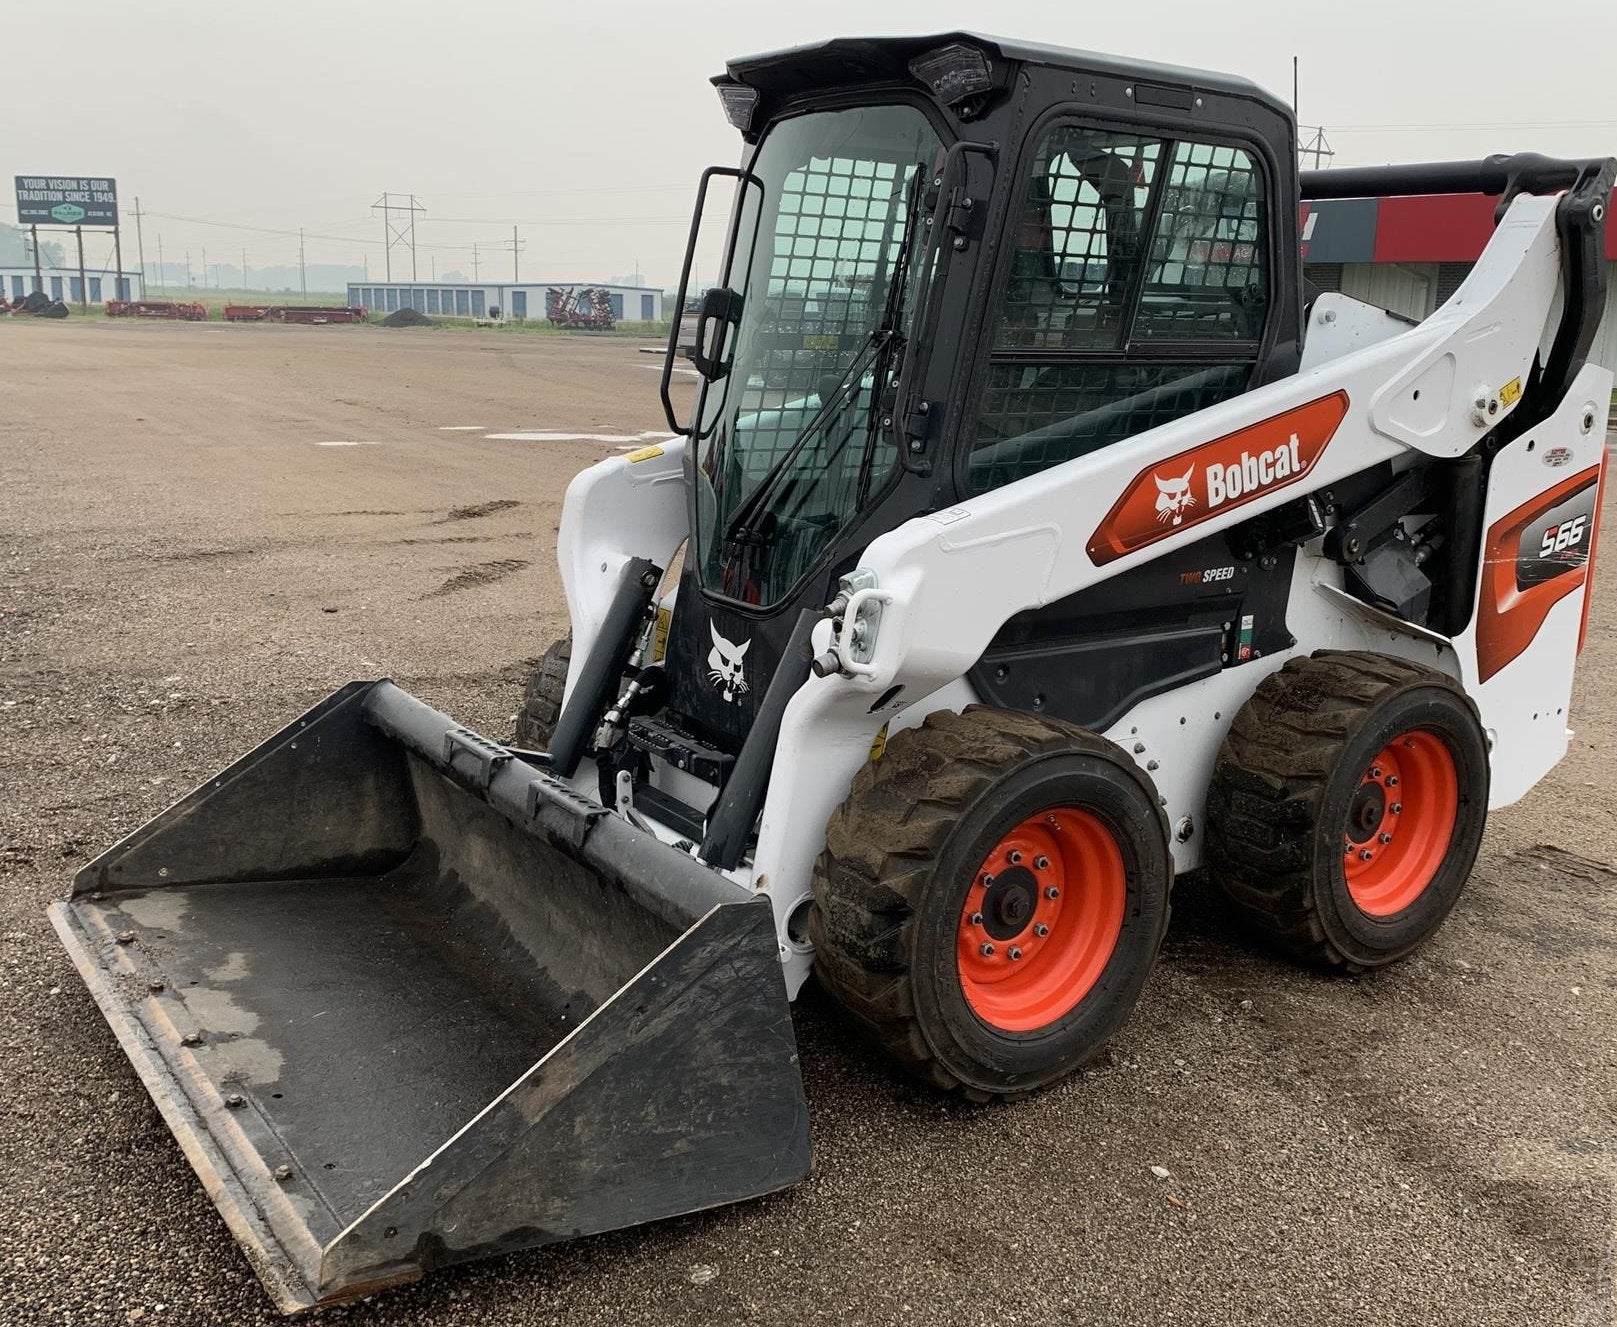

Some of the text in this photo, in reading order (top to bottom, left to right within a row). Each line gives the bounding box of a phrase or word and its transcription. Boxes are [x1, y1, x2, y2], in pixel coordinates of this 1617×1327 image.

[23, 179, 108, 191] YOUR VISION IS OUR
[17, 190, 63, 201] TRADITION
[65, 191, 91, 202] SINCE
[1206, 433, 1300, 508] Bobcat
[1539, 514, 1587, 558] S66
[1203, 566, 1235, 582] SPEED
